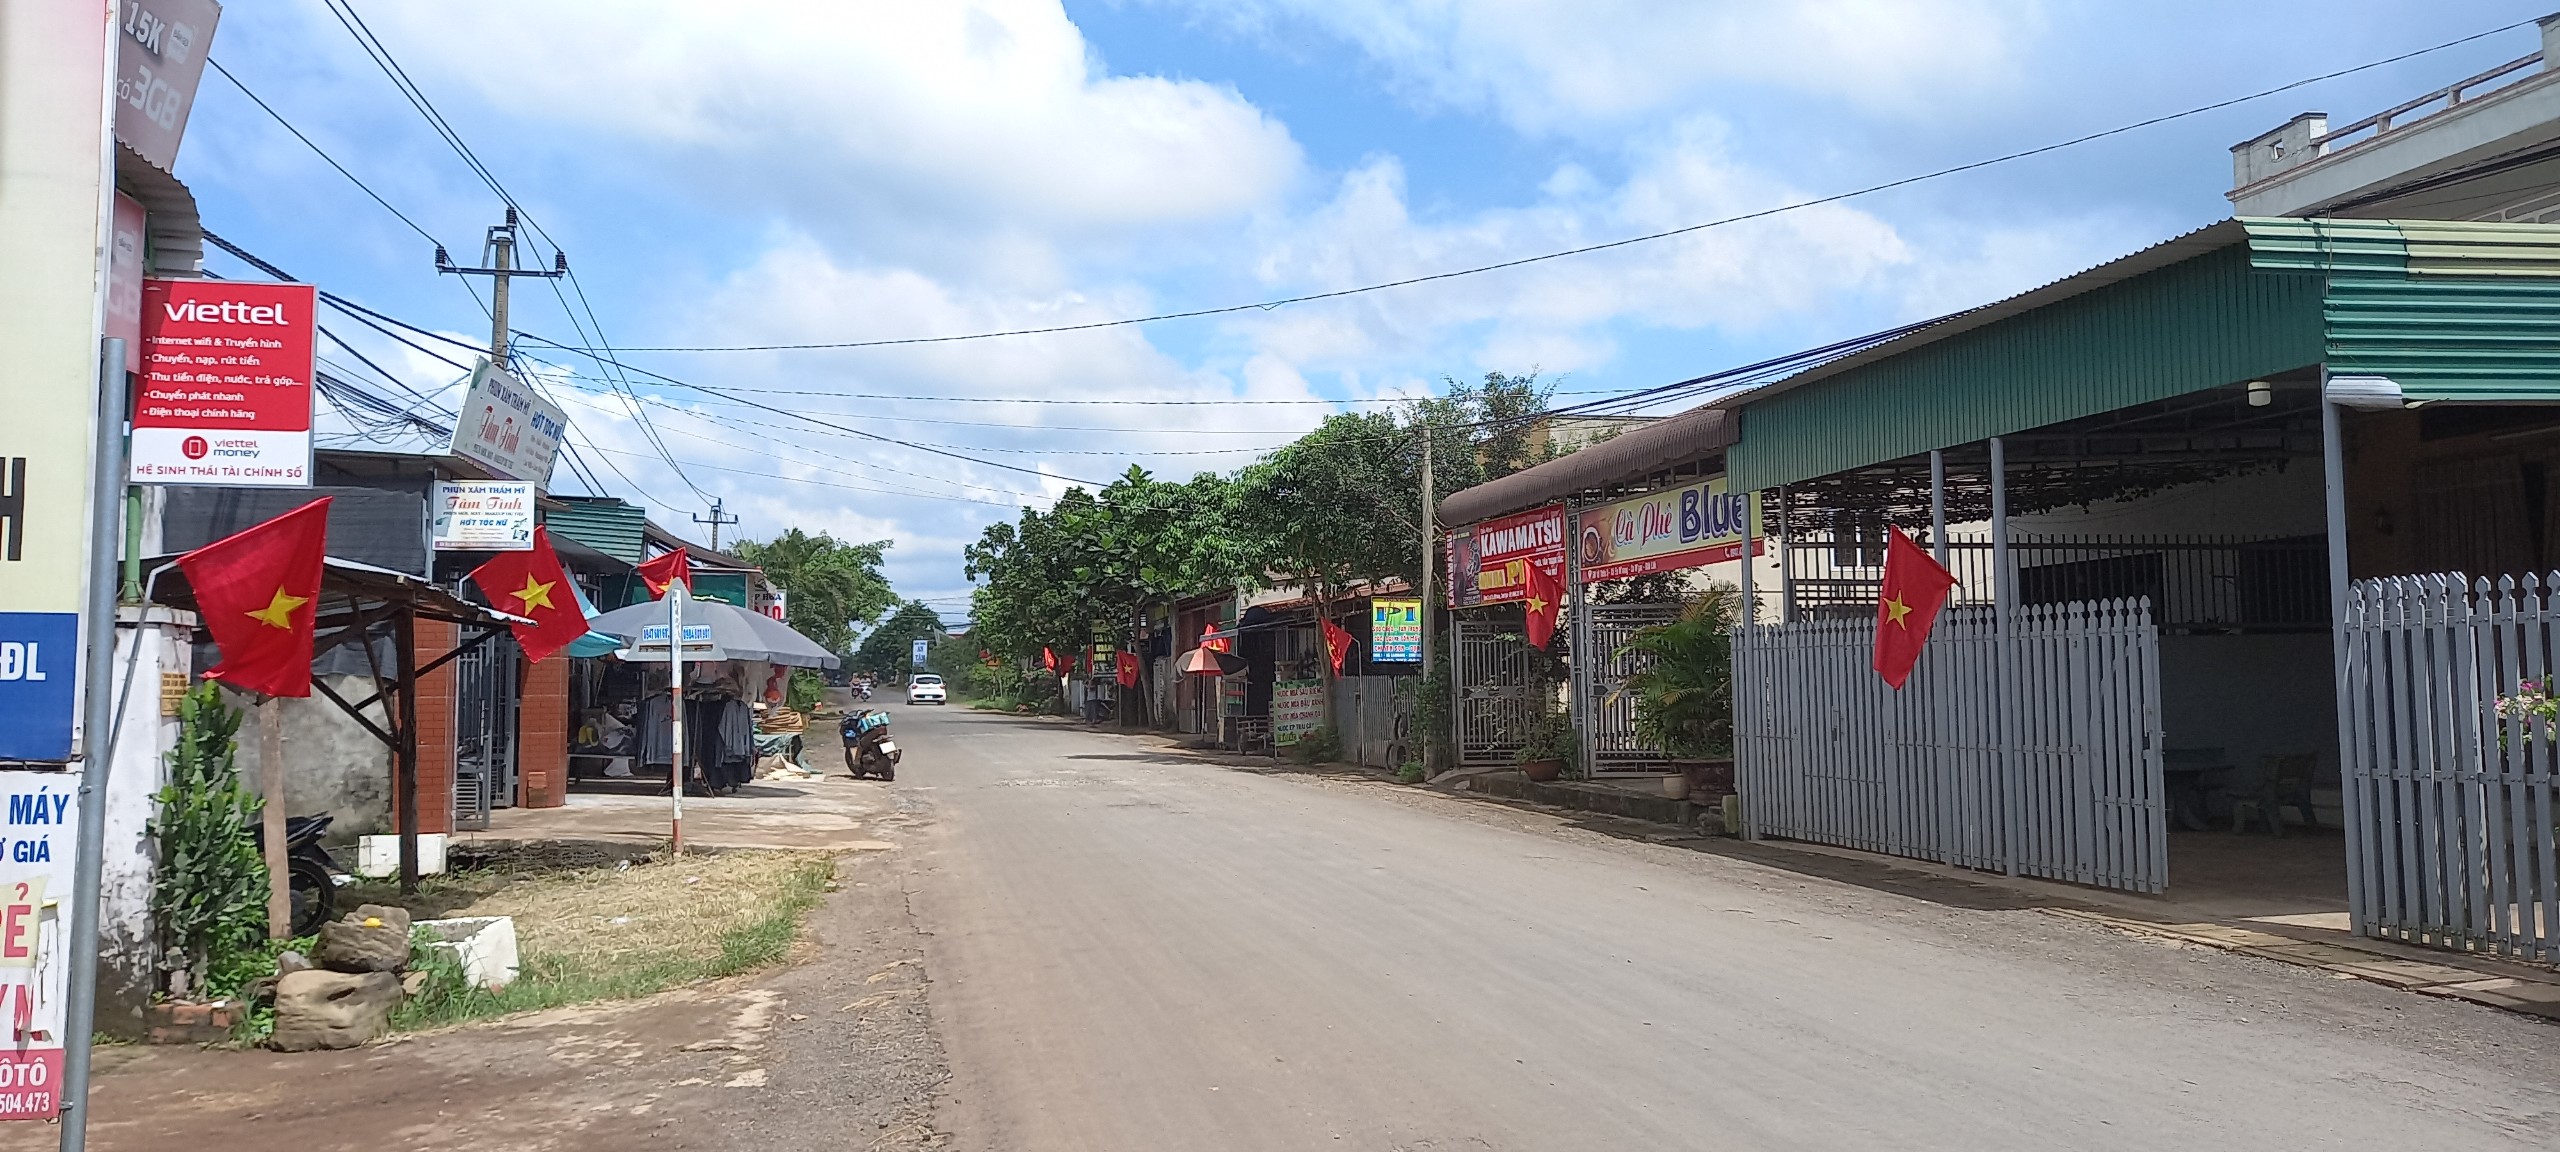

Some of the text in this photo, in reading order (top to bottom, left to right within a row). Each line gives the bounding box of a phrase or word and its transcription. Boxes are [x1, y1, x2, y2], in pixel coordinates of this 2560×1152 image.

[124, 2, 166, 55] 15K
[130, 64, 181, 131] 3GB
[164, 299, 288, 324] viettel
[152, 336, 192, 346] Internet
[194, 336, 212, 346] wifi
[214, 338, 222, 346] &
[150, 372, 170, 382] Thu
[188, 391, 212, 402] phát
[213, 392, 244, 401] nhanh
[149, 407, 256, 420] Điện thoại chính hãng
[214, 440, 258, 448] viettel
[214, 449, 260, 458] money
[156, 466, 186, 475] SINH
[190, 465, 218, 476] THÁI
[222, 466, 240, 476] TÀI
[244, 466, 282, 477] CHÍNH
[286, 465, 303, 478] SỐ
[1614, 484, 1743, 548] Cà Phê Blue
[1480, 516, 1562, 558] KAWAMATSU
[1446, 534, 1455, 606] KAWAMATSU
[10, 786, 70, 825] MÁY
[13, 834, 51, 862] GIÁ
[0, 882, 32, 958] Ẻ
[0, 1057, 48, 1088] ÔTÔ
[0, 1092, 50, 1114] 504.473
